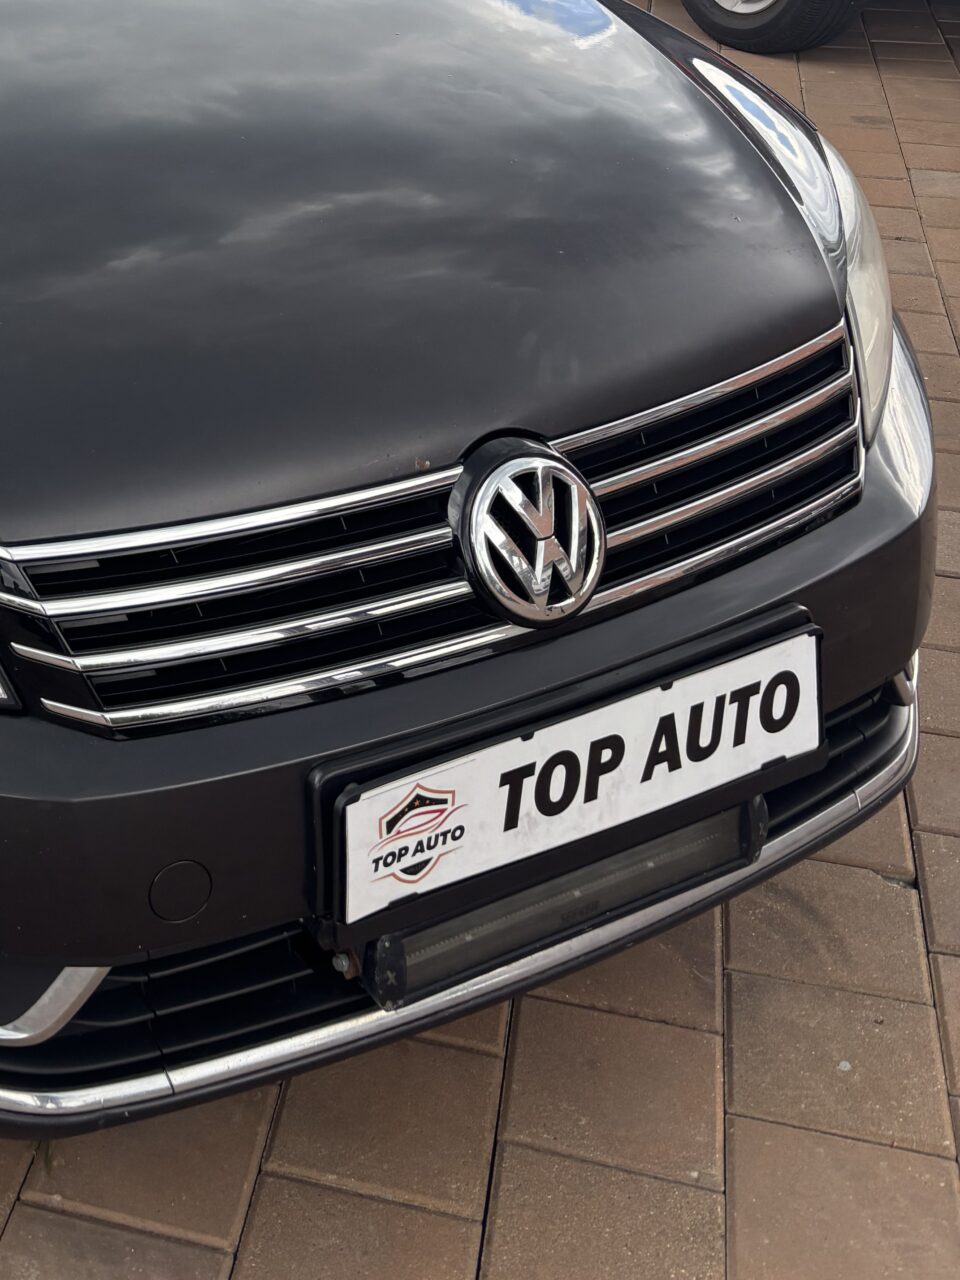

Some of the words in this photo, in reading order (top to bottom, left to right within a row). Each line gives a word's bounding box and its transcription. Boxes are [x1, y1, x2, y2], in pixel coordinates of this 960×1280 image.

[499, 733, 626, 832] TOP
[640, 669, 801, 784] AUTO
[372, 845, 410, 873] TOP
[411, 824, 465, 857] AUTO
